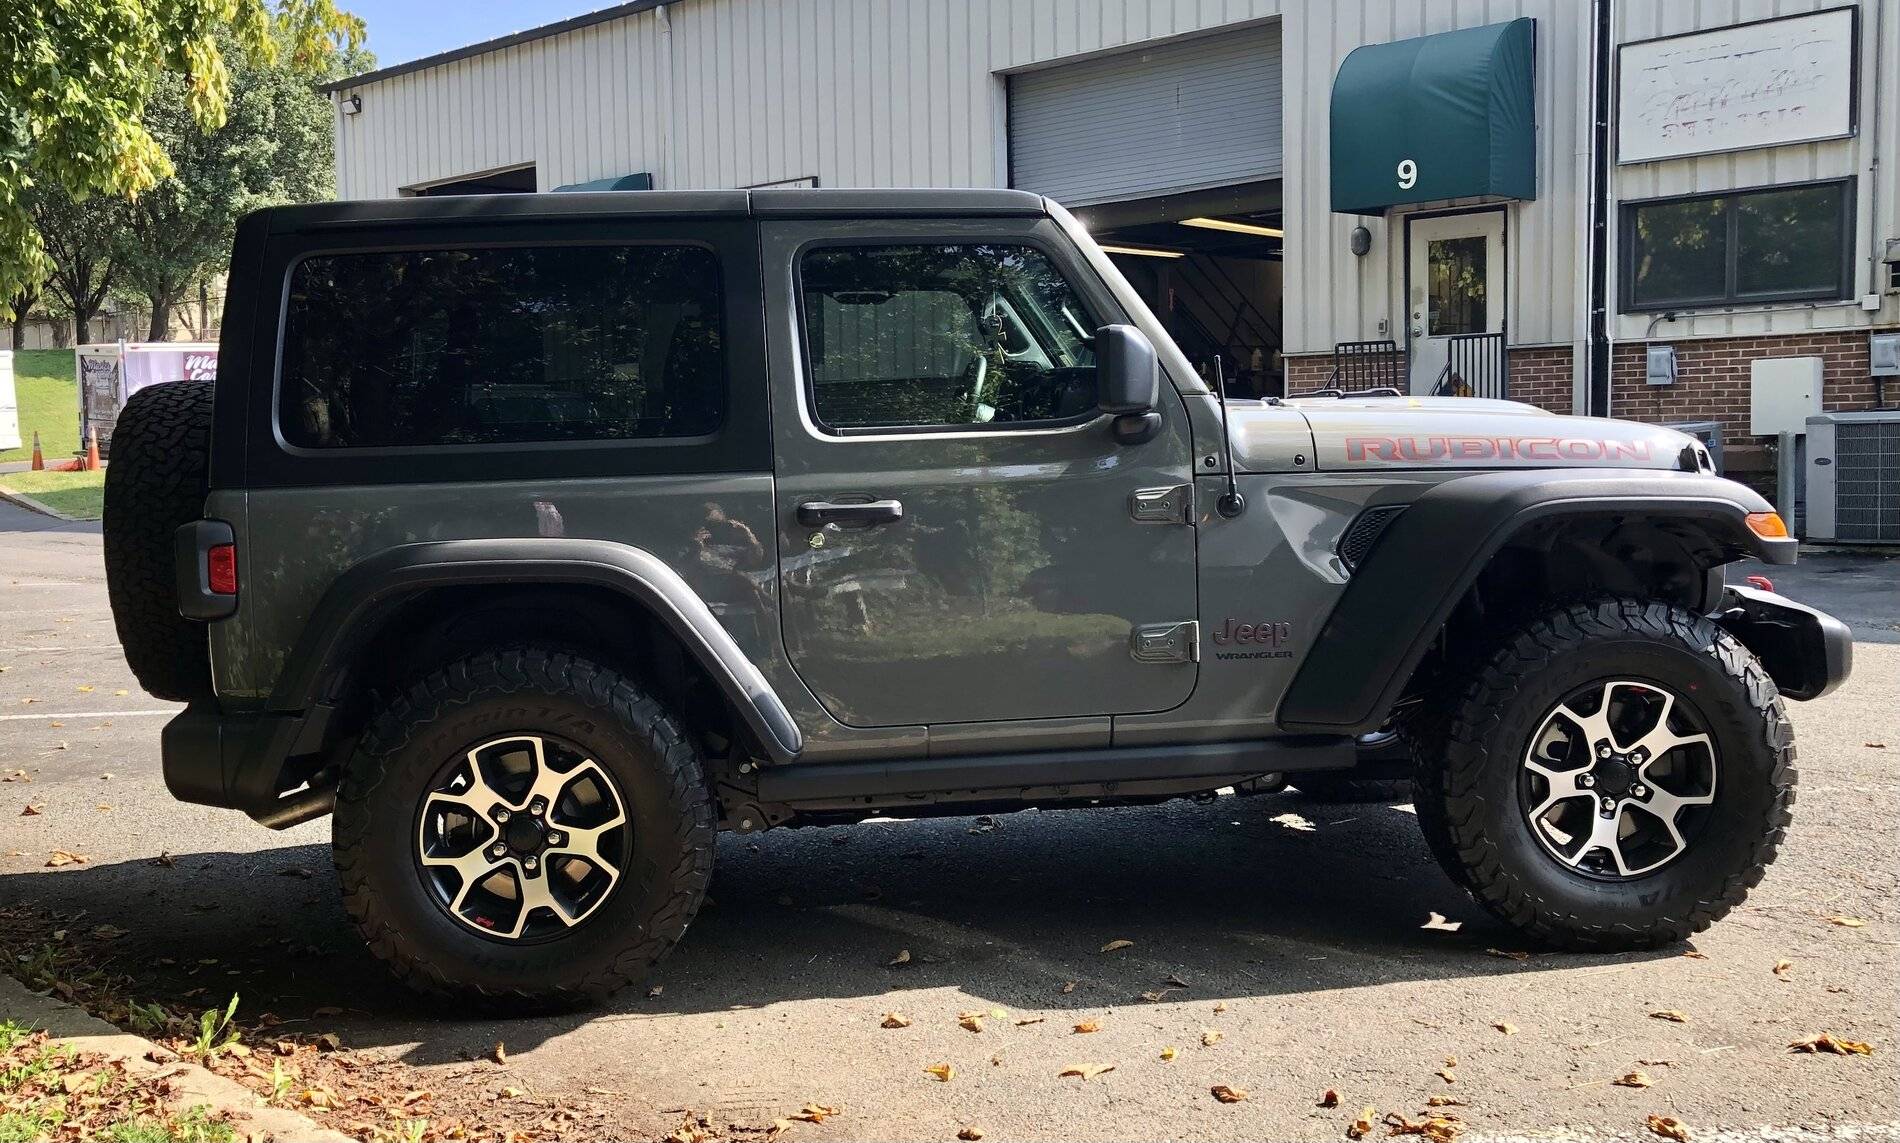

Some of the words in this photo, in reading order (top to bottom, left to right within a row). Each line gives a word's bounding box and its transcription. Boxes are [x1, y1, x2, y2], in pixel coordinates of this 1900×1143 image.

[1397, 159, 1418, 190] 9
[1346, 437, 1652, 462] RUBICON
[1212, 617, 1292, 648] Jeep
[1215, 650, 1294, 661] WRANGLER
